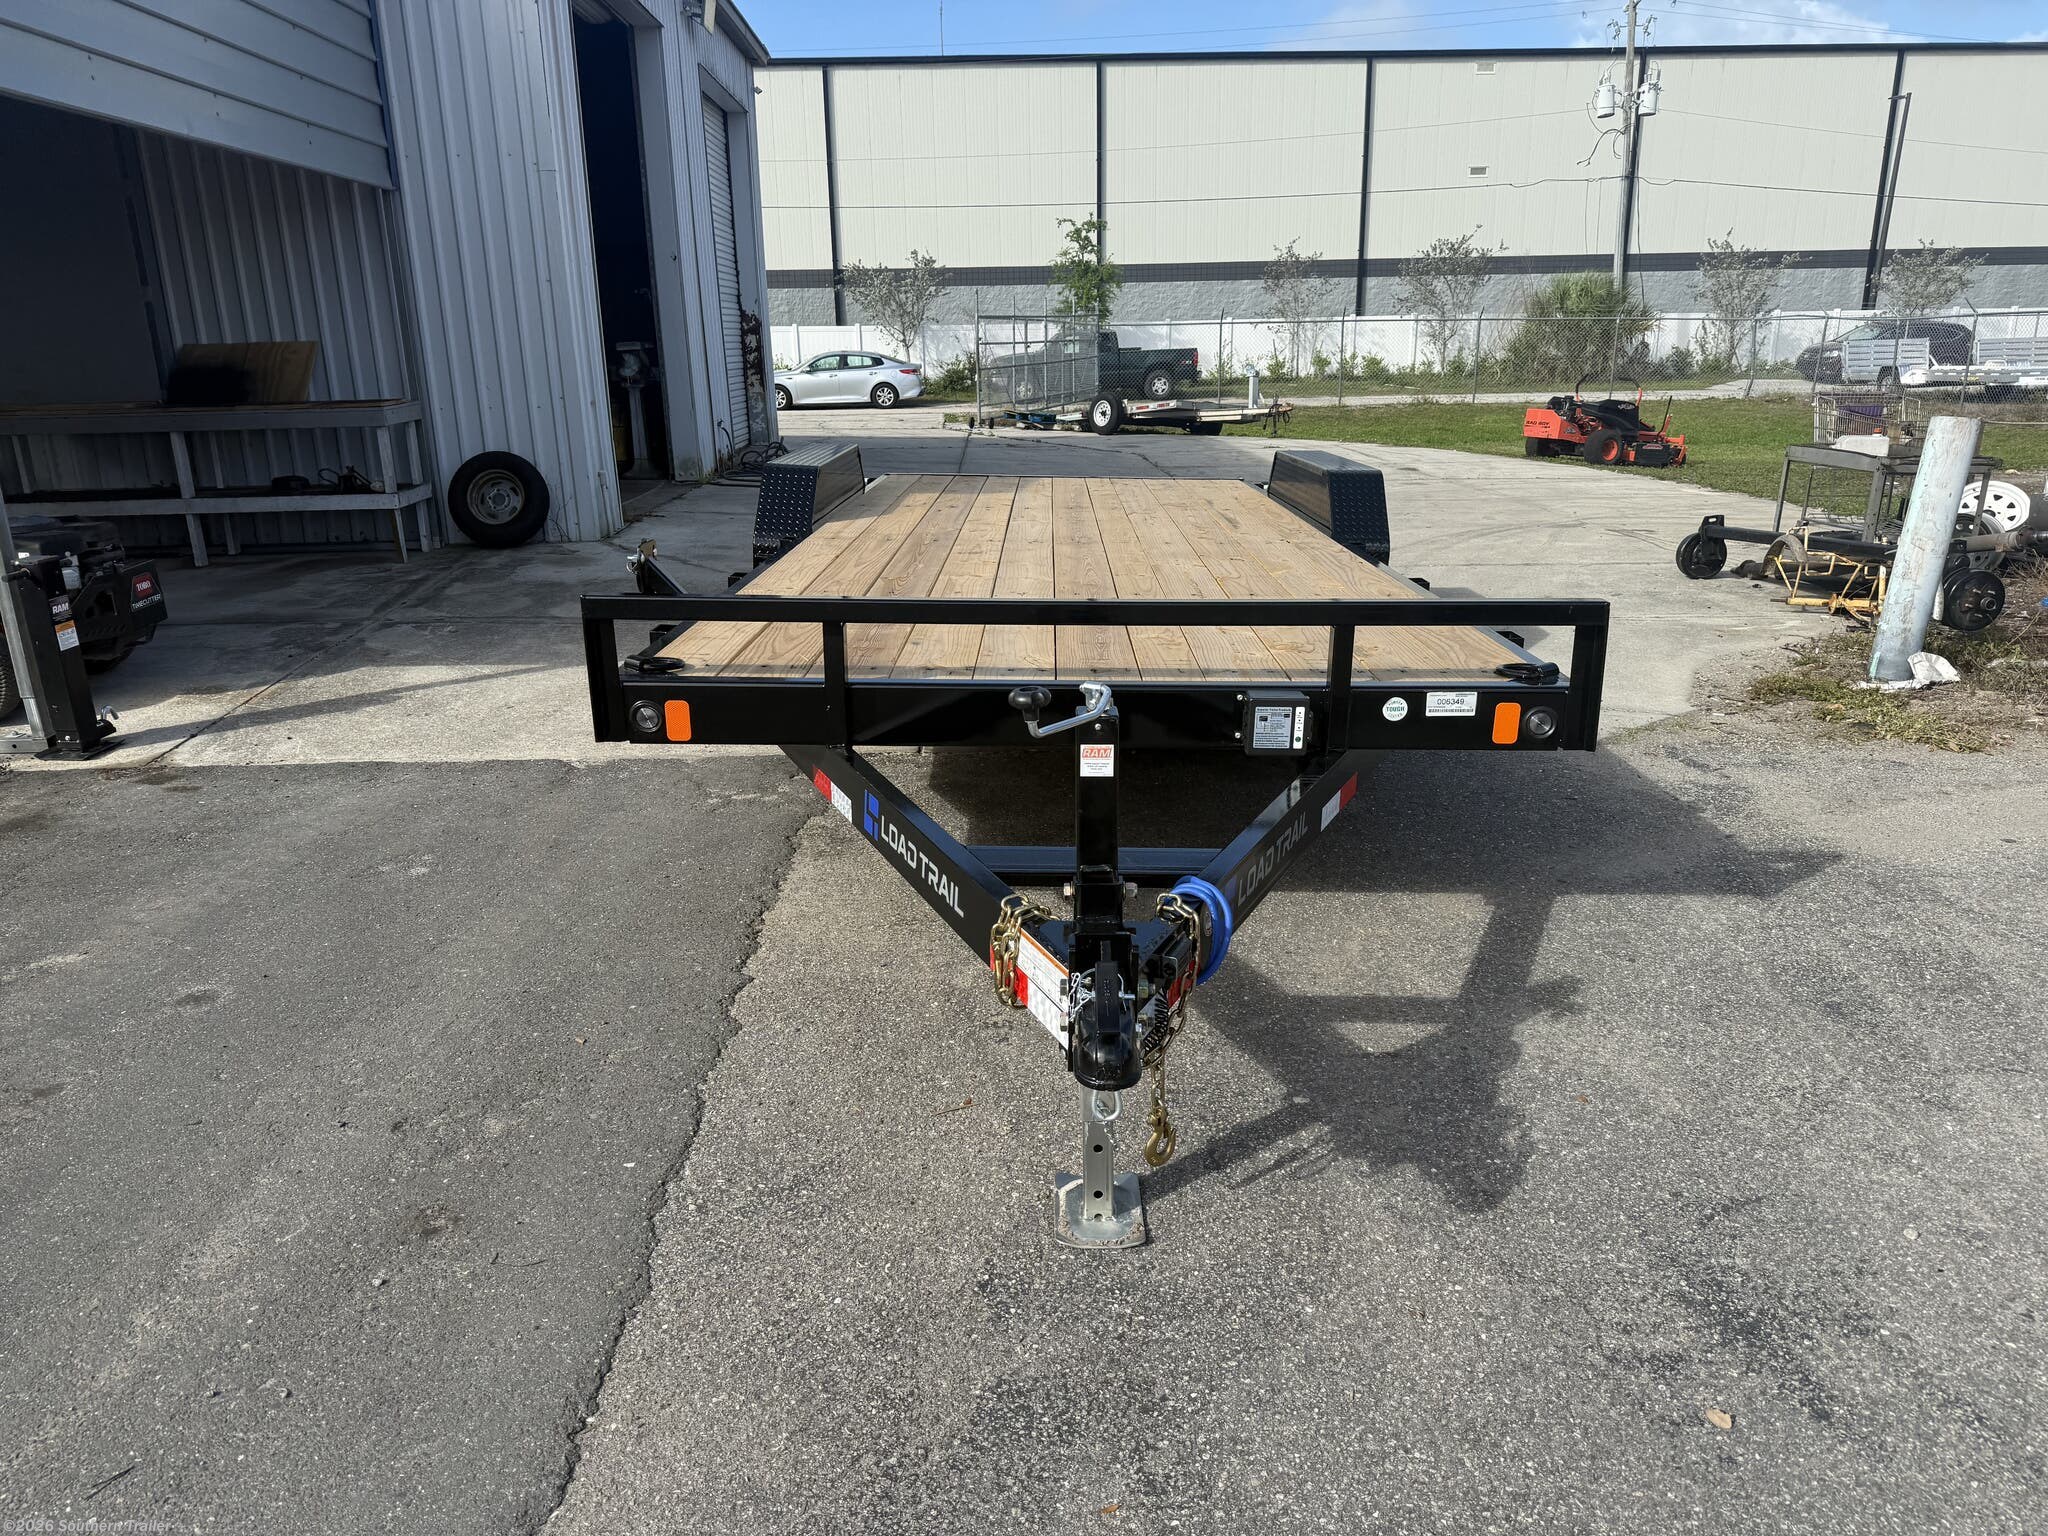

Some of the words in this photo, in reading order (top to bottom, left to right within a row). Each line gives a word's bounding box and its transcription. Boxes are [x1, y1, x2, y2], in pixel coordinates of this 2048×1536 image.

[136, 580, 151, 591] TORO
[52, 602, 69, 614] RAM
[1082, 748, 1112, 758] RAM
[1237, 845, 1275, 906] LOAD
[1276, 811, 1308, 863] TRAIL
[881, 815, 917, 869] LOAD
[919, 851, 965, 918] TRAIL
